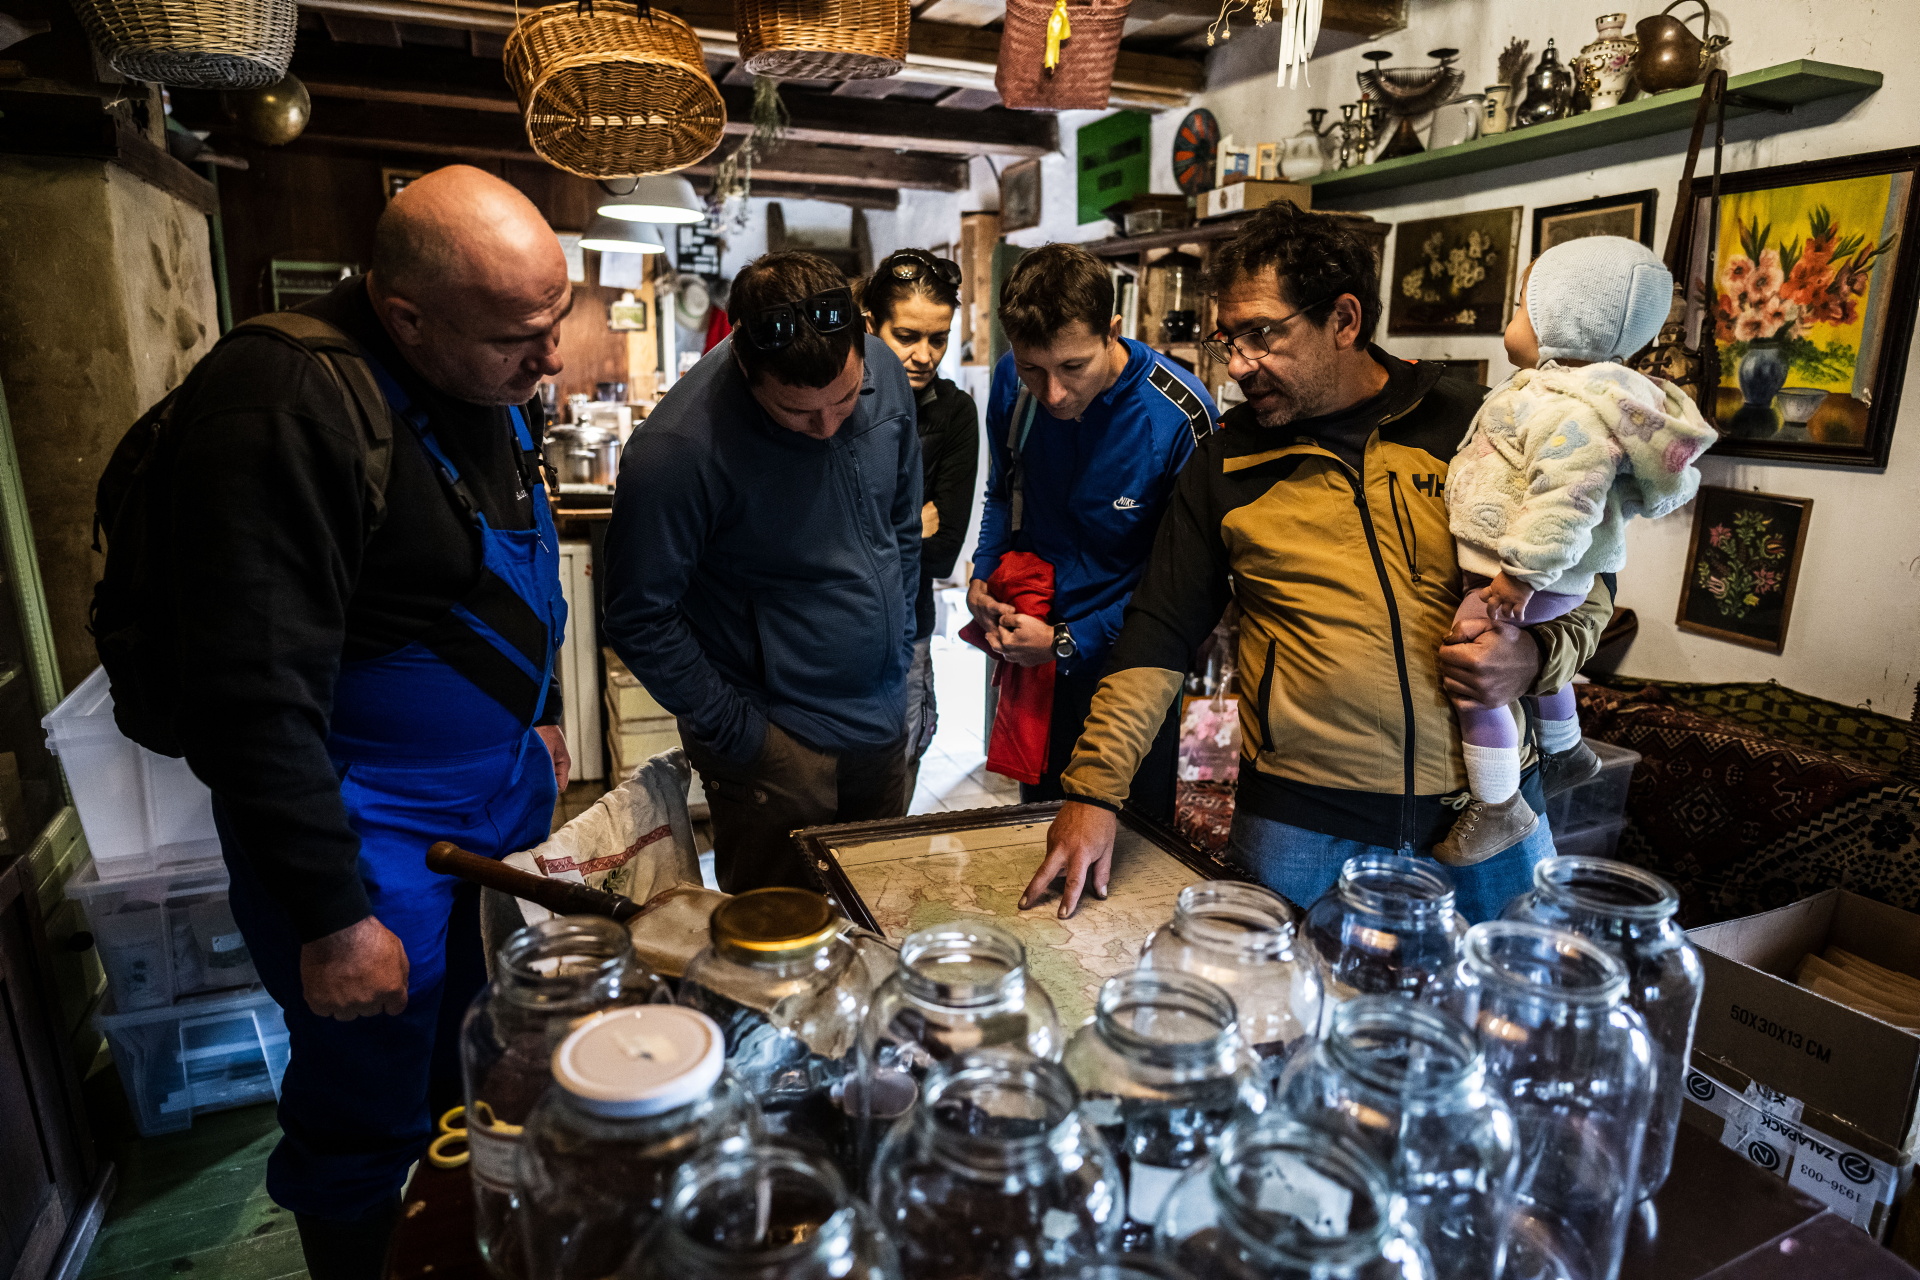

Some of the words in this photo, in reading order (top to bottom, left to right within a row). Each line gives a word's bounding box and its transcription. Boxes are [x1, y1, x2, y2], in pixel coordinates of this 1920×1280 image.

[1117, 495, 1137, 508] NIKE
[1411, 473, 1447, 498] HH
[1730, 1004, 1803, 1049] 50X30X13
[1805, 1039, 1832, 1064] CM
[1760, 1115, 1834, 1162] ZALAPACK
[1800, 1163, 1862, 1203] 1936-003
